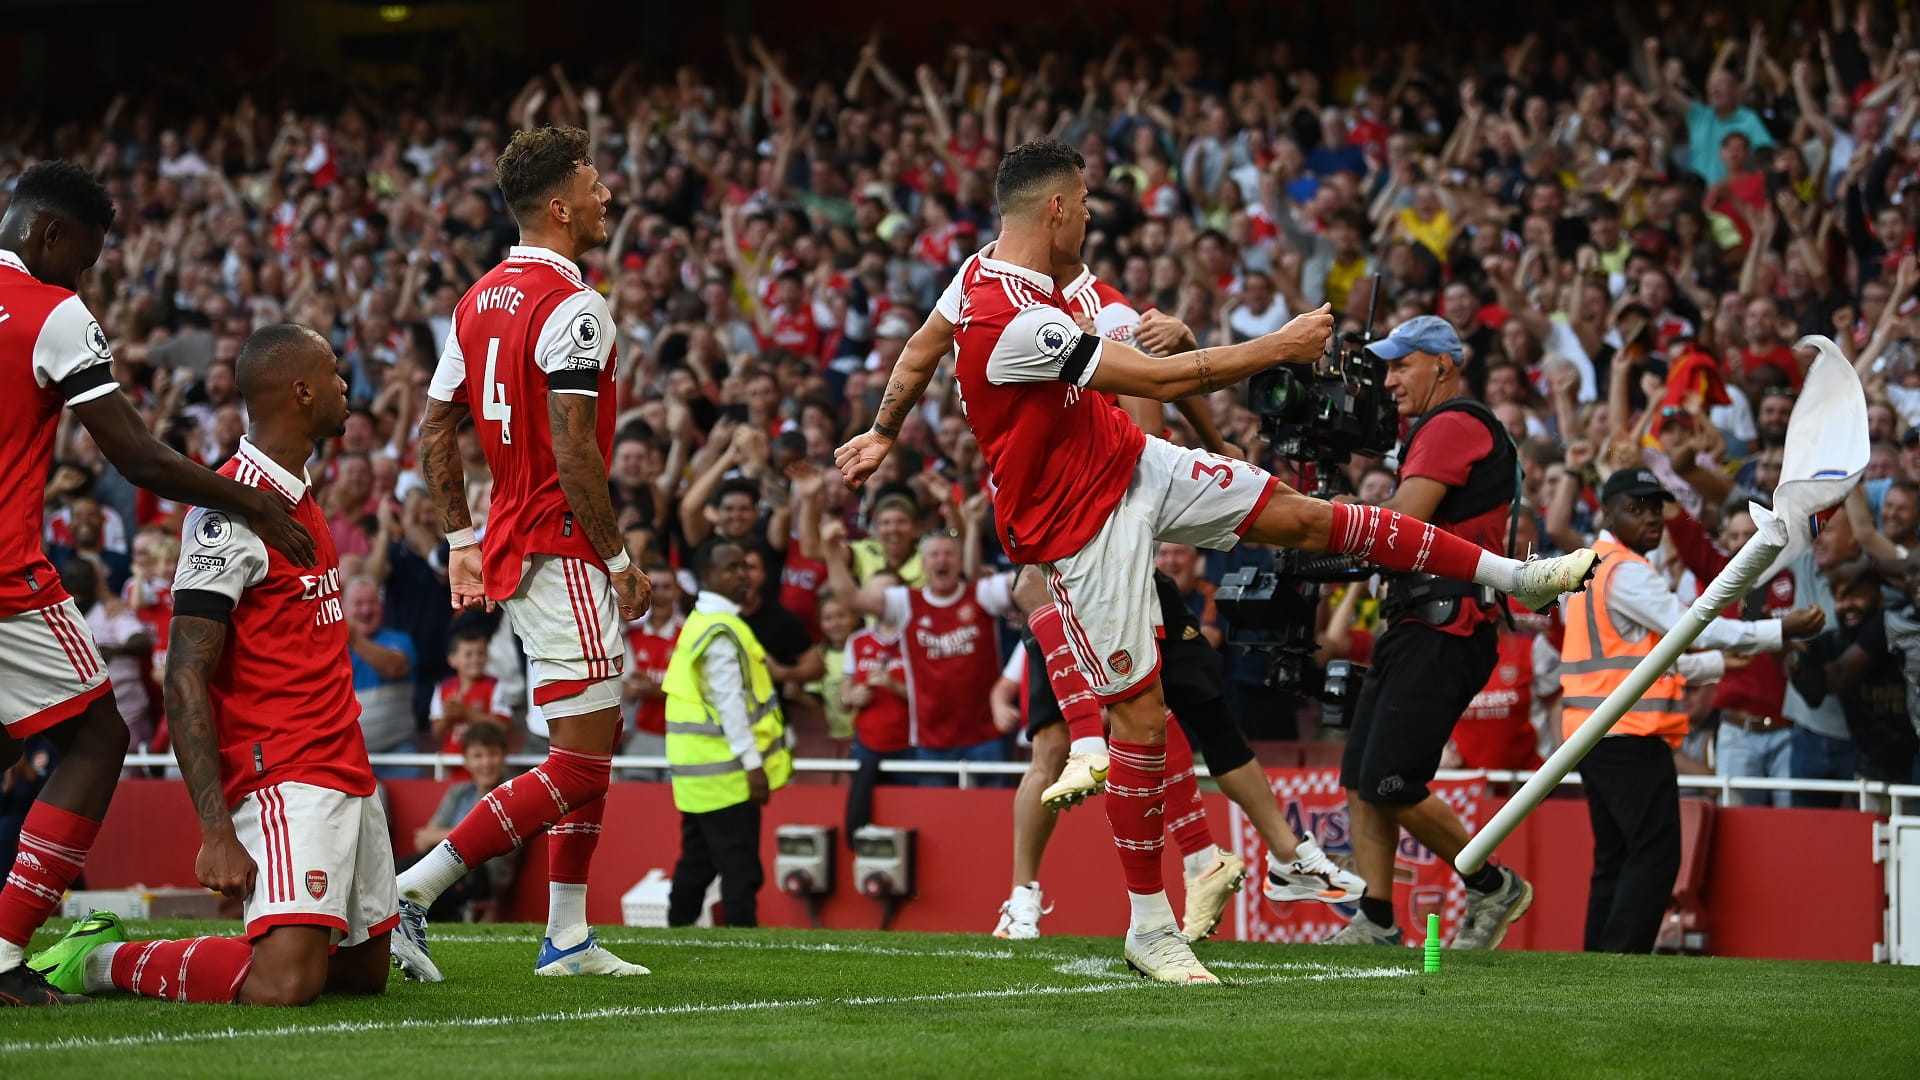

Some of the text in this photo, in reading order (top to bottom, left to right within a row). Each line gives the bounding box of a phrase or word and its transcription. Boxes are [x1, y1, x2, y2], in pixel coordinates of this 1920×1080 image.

[476, 285, 525, 316] WHITE
[578, 358, 598, 367] room
[482, 337, 512, 445] 4
[1191, 453, 1234, 490] 3
[1387, 511, 1401, 551] AFC
[200, 557, 222, 566] room
